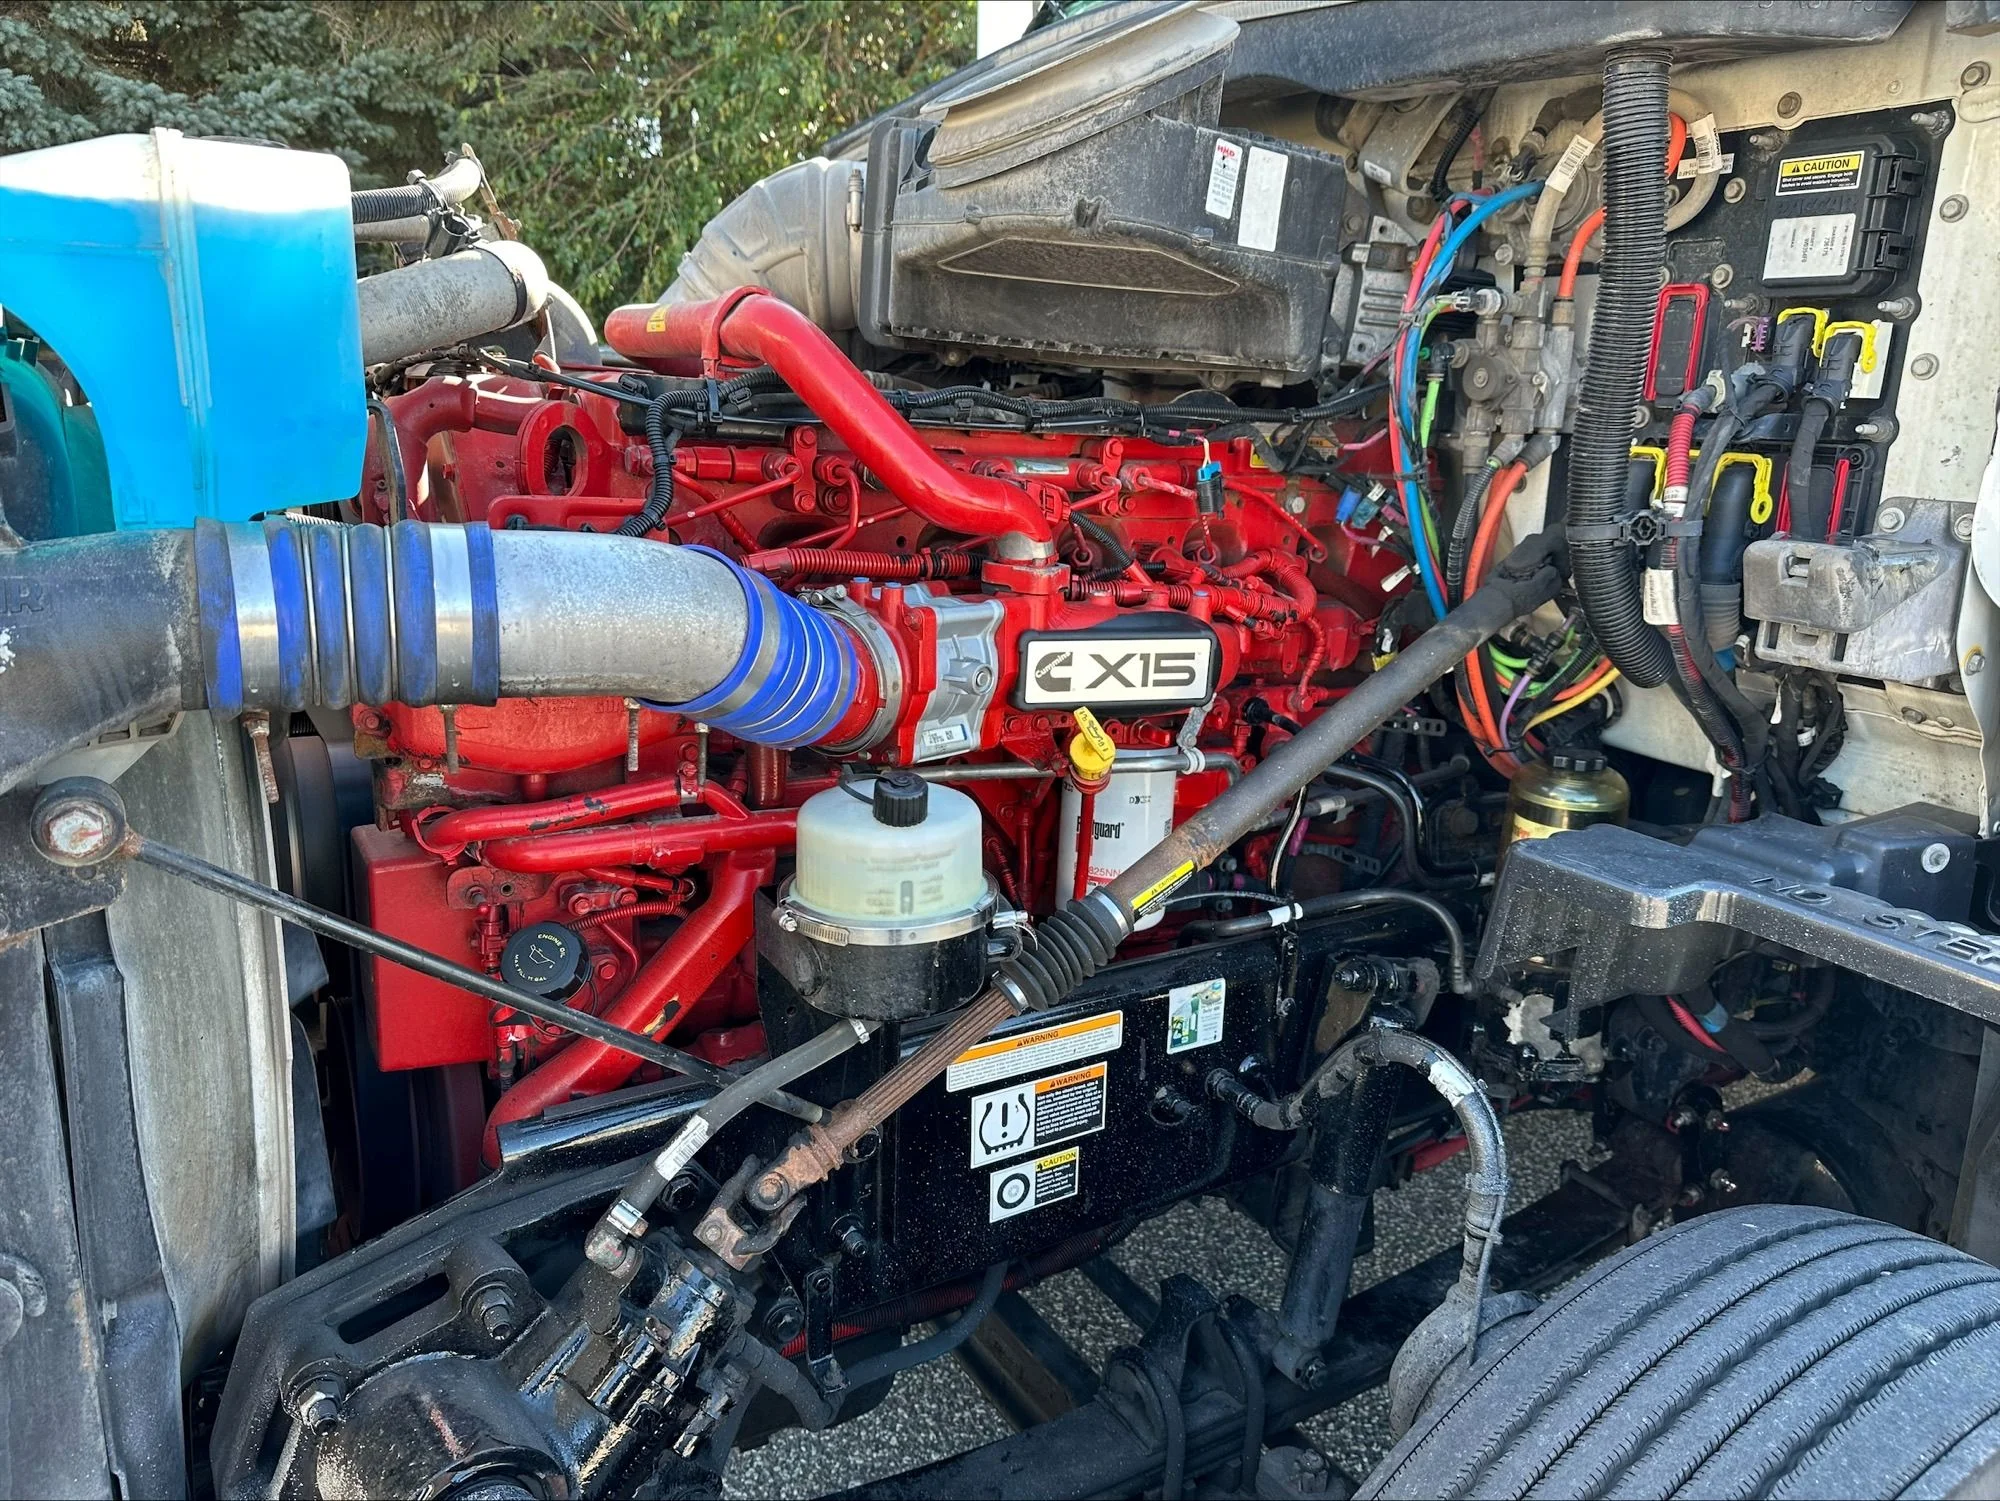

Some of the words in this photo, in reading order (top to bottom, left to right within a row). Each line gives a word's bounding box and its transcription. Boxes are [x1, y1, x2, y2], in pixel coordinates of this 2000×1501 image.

[1803, 159, 1850, 172] CAUTION
[1035, 652, 1072, 679] Cummins
[1085, 652, 1196, 690] X15
[1750, 875, 1834, 904] NO
[538, 933, 563, 947] ENGINE
[1023, 1030, 1059, 1046] WARNING
[1056, 1072, 1092, 1087] WARNING
[1043, 1152, 1076, 1167] CAUTION
